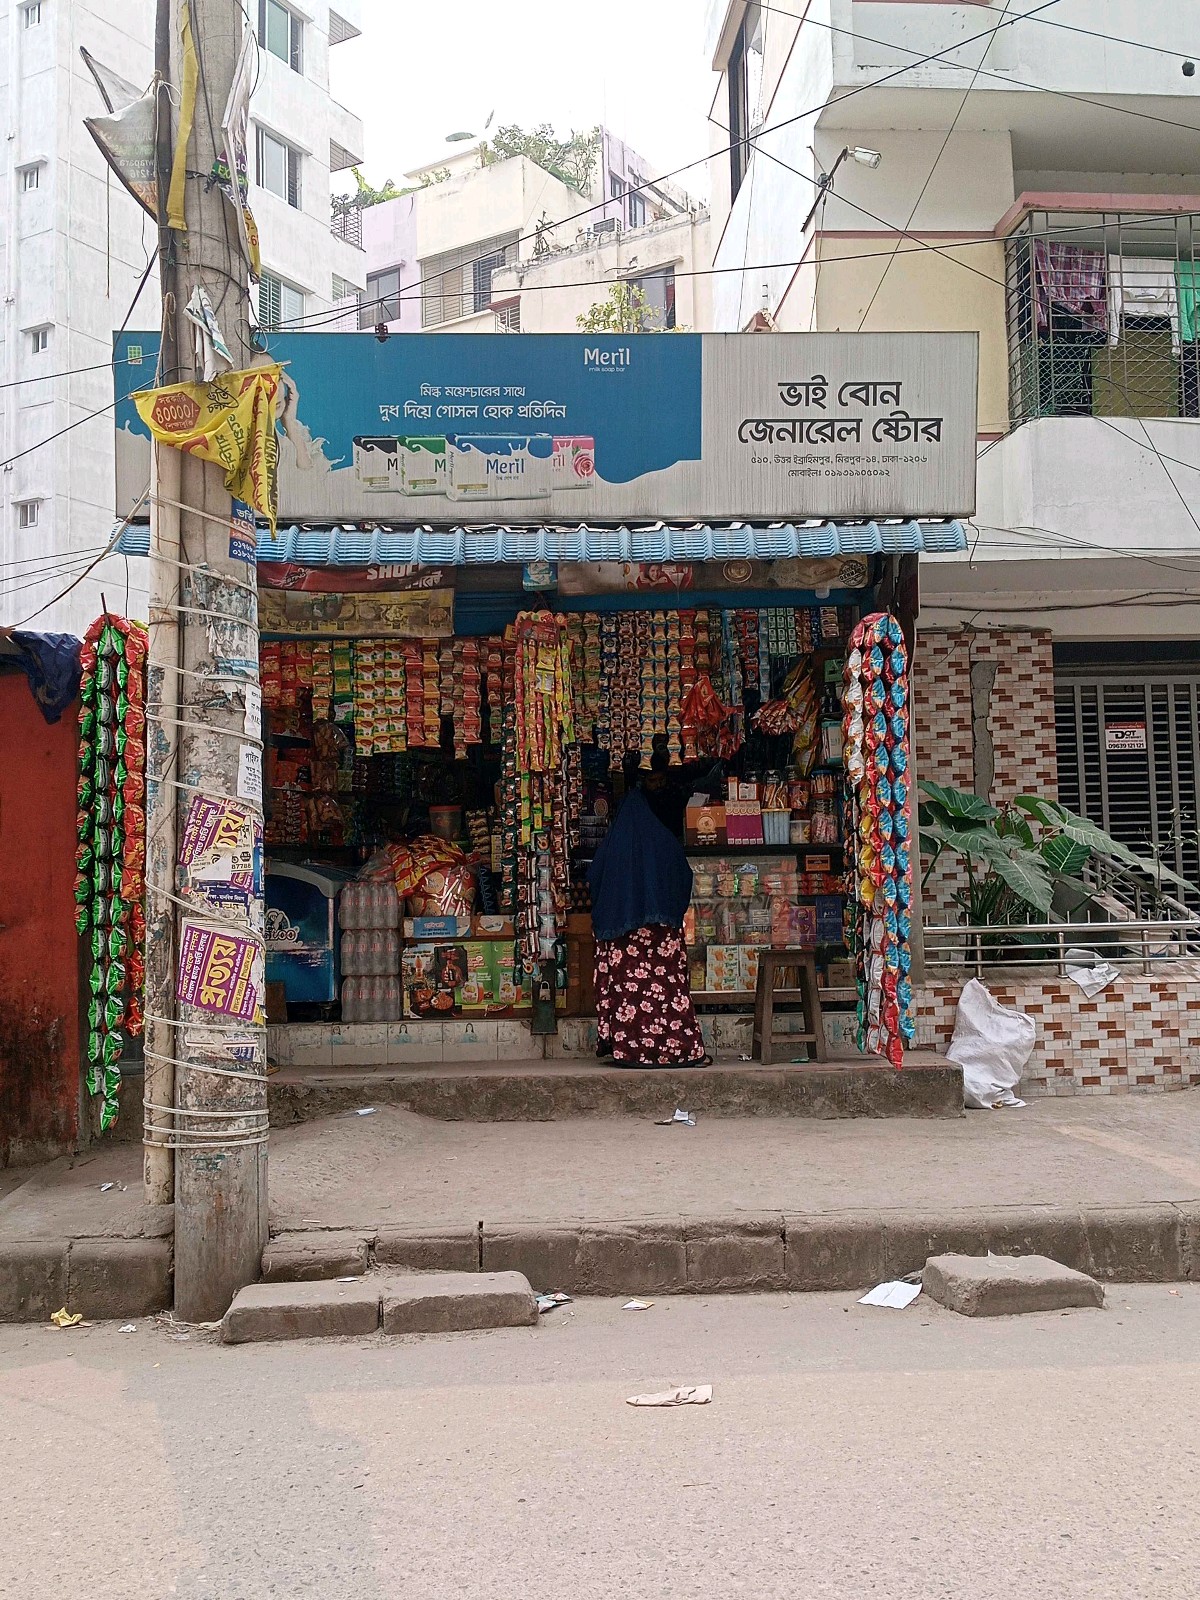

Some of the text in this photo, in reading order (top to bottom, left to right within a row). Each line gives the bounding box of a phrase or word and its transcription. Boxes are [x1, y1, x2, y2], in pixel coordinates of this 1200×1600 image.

[584, 347, 630, 365] Meril
[420, 383, 442, 398] মিল্ক
[503, 386, 526, 397] সাথে
[778, 374, 902, 410] ভাই বোন
[379, 400, 567, 422] দুধ দিয়ে গোসল হোক প্রতিদিন
[738, 410, 943, 445] জেনারেল ষ্টোর
[486, 458, 525, 474] Meril
[751, 456, 772, 465] ৫১০,
[774, 454, 791, 463] উত্তর
[1109, 730, 1137, 739] DOT
[199, 937, 236, 1008] প্রত্যয়
